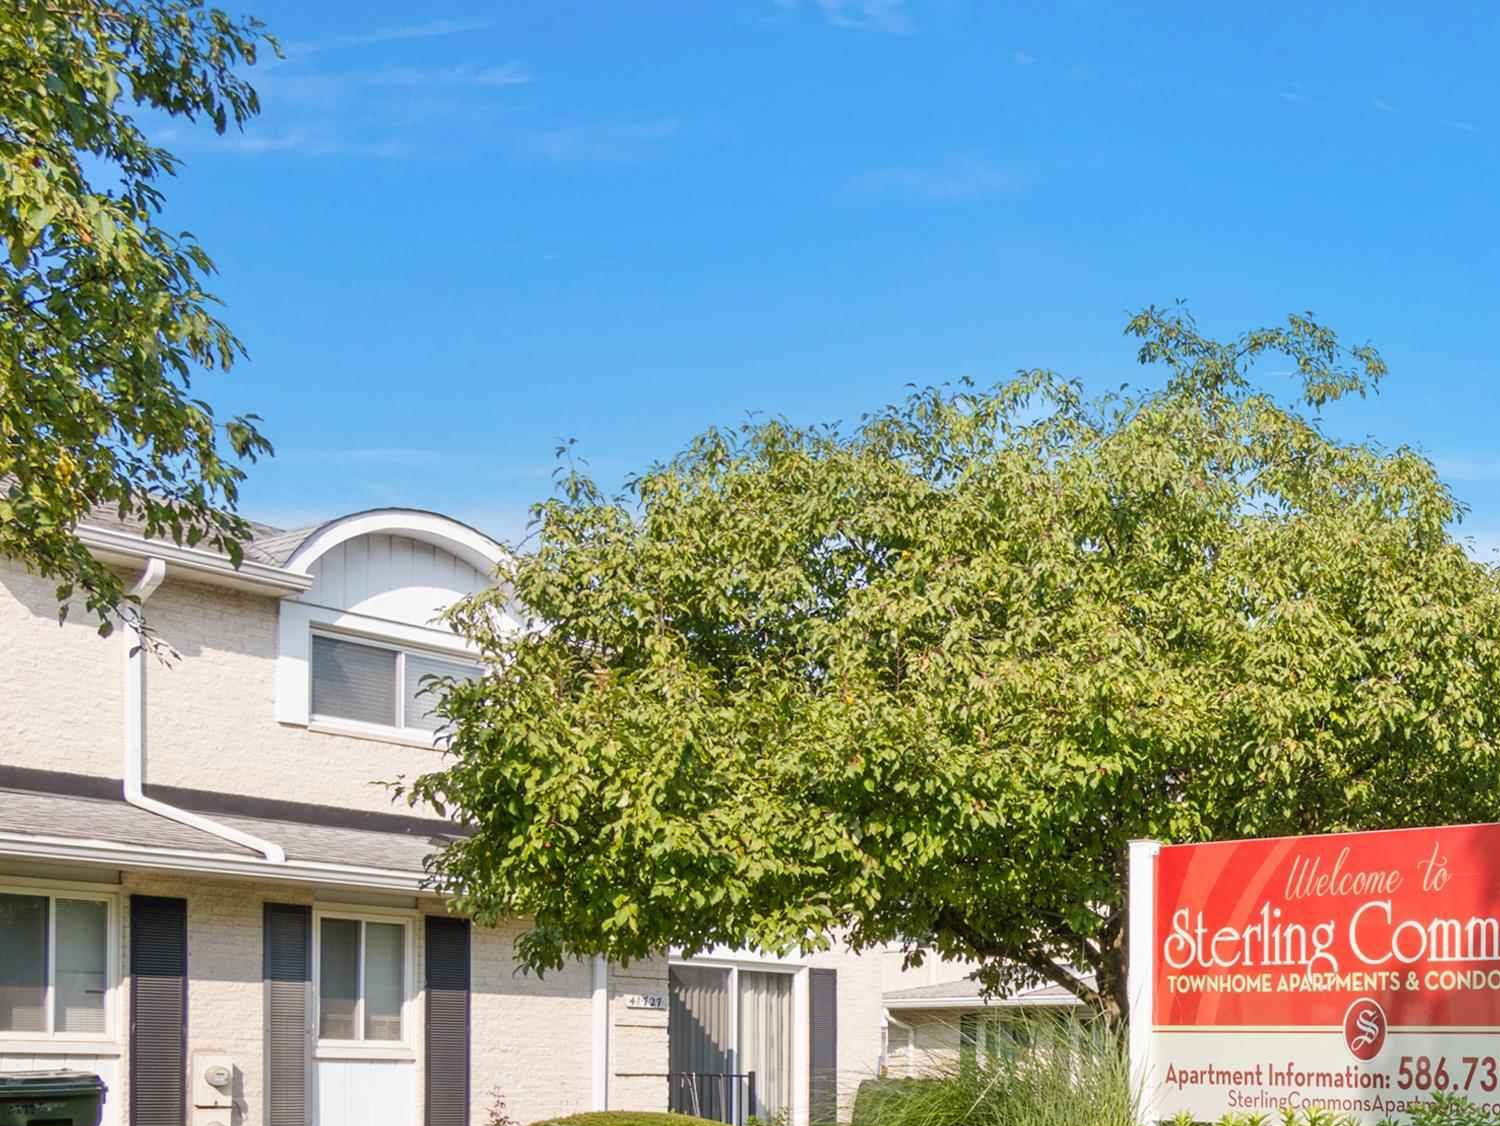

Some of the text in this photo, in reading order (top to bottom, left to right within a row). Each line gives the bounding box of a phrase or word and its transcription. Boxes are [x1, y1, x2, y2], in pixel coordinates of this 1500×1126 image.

[1284, 841, 1451, 900] Welcome to
[1164, 901, 1338, 989] Sterling
[1167, 973, 1272, 993] TOWNHOME
[1276, 971, 1400, 993] APARTMENTS
[1405, 973, 1420, 991] &
[1165, 1062, 1263, 1090] Apartment
[1268, 1062, 1391, 1089] Information:
